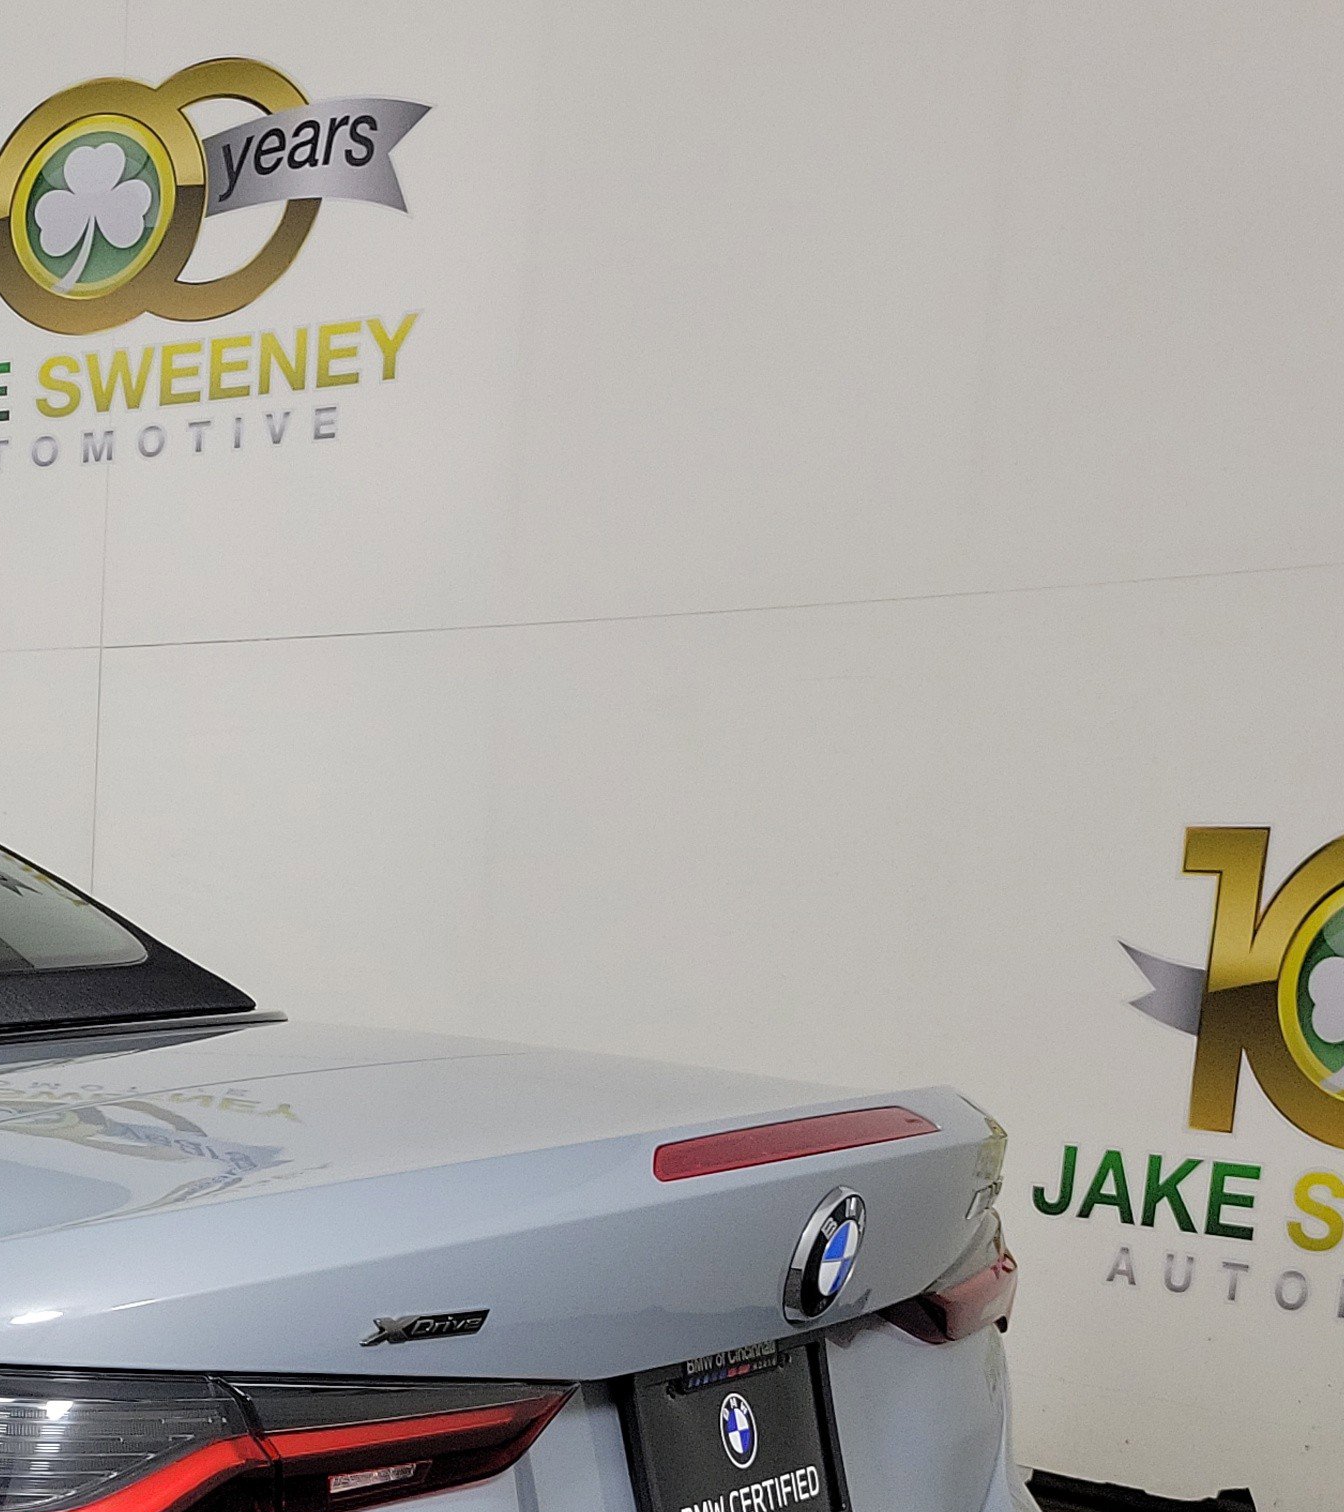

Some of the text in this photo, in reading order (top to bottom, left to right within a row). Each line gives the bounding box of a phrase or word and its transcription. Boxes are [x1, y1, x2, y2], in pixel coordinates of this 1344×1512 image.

[216, 111, 378, 199] years
[34, 312, 419, 420] SWEENEY
[1032, 1145, 1262, 1241] JAKE
[1105, 1246, 1344, 1319] AUTO
